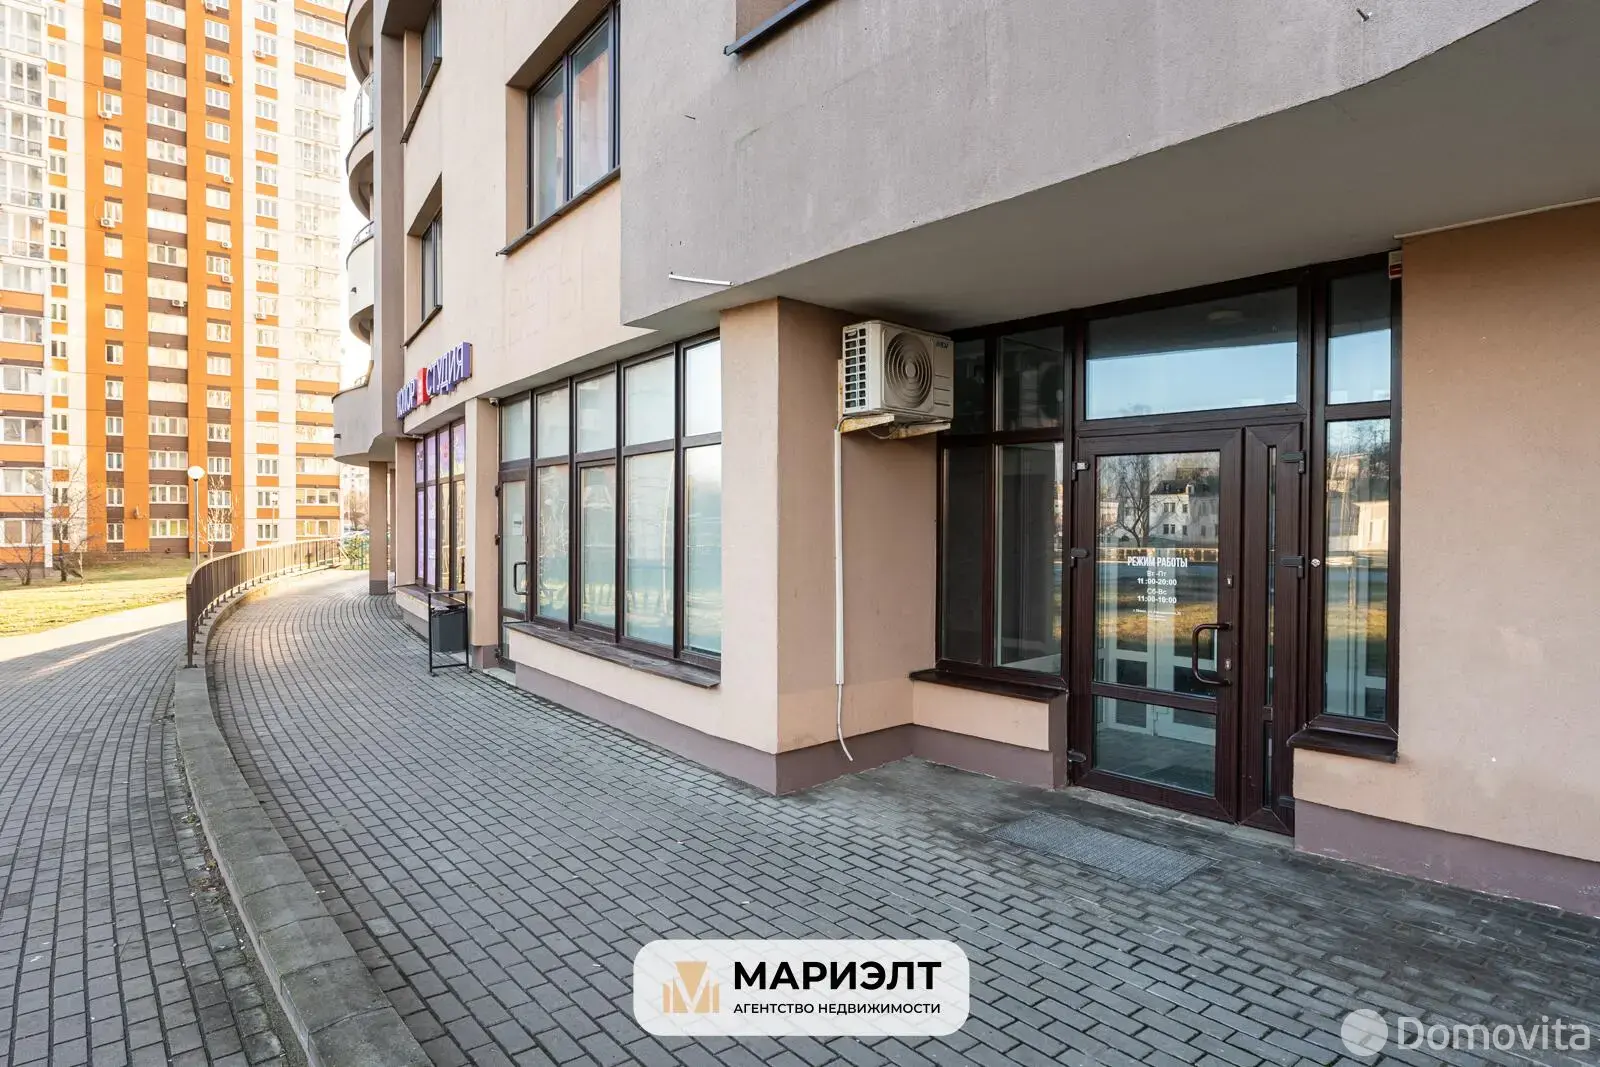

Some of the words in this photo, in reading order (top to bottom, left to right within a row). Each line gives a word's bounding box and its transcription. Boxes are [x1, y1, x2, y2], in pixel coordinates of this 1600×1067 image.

[426, 342, 464, 396] СТУДИЯ
[1127, 556, 1156, 567] РЕЖИМ
[1157, 556, 1188, 567] РАБОТЫ
